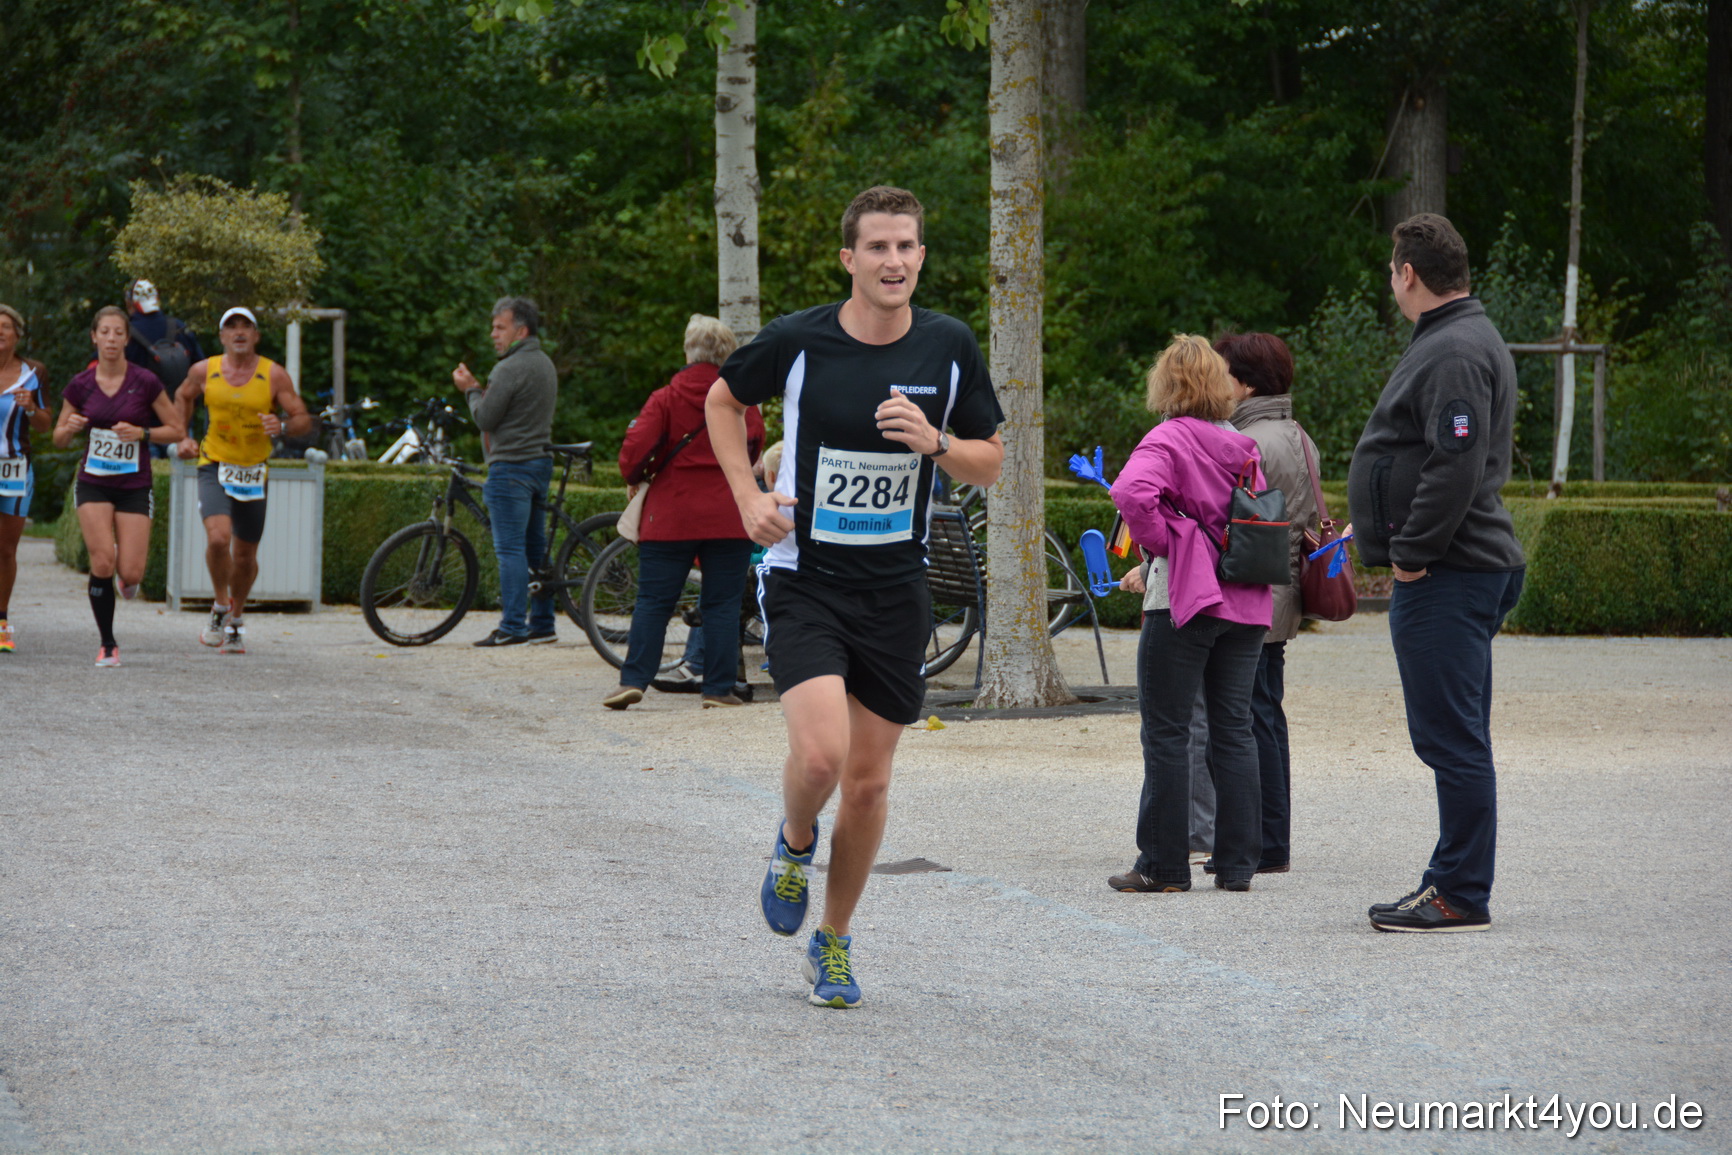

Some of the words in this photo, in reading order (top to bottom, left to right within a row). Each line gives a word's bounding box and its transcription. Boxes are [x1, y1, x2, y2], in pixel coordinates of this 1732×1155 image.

[897, 385, 938, 395] PFLEIDERER
[93, 440, 135, 460] 2240
[0, 462, 20, 478] 01
[821, 456, 857, 471] PARTL
[858, 461, 907, 472] Neumarkt
[826, 473, 911, 509] 2284
[838, 516, 893, 531] Dominik
